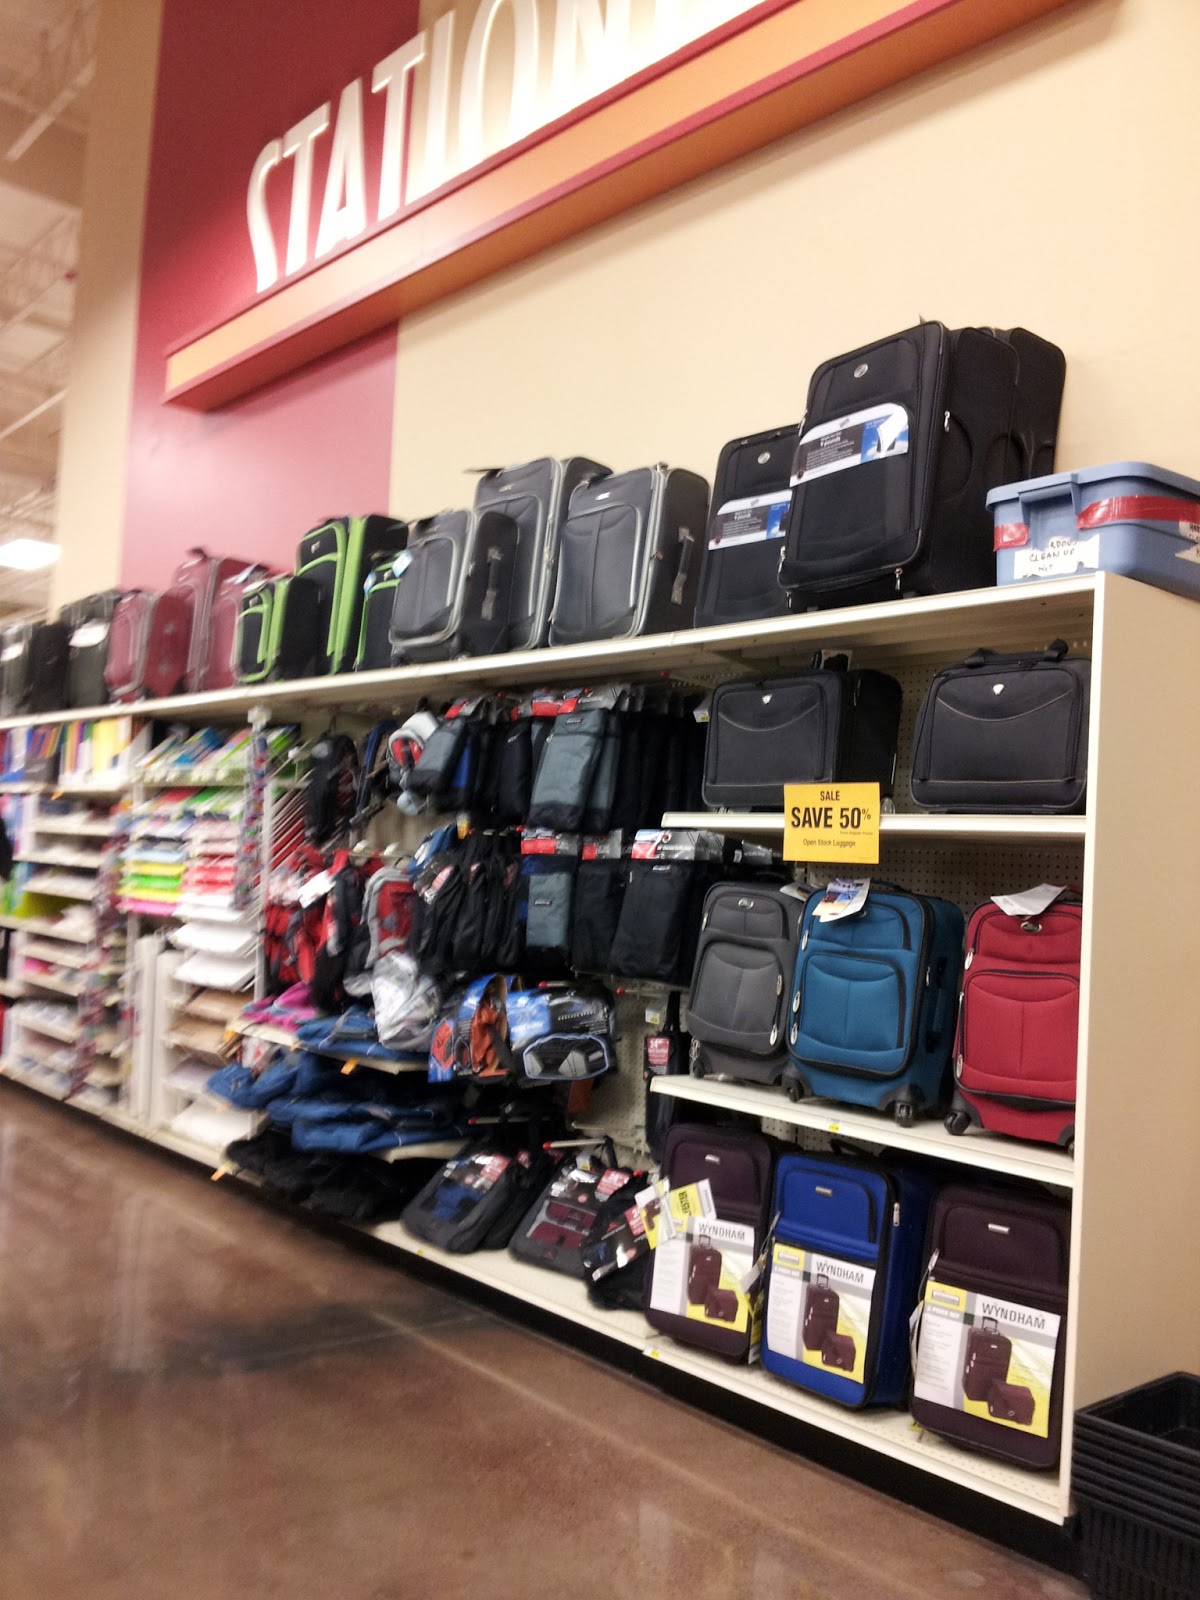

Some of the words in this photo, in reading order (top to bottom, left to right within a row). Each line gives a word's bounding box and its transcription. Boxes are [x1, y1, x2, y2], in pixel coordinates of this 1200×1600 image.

[247, 0, 690, 293] STATION
[820, 790, 840, 801] SALE
[791, 806, 833, 829] SAVE
[840, 807, 871, 829] 50%
[803, 838, 816, 847] Open
[817, 838, 832, 846] Stock
[833, 840, 856, 848] Luggage
[699, 1223, 745, 1241] WYNDHAM
[816, 1260, 865, 1284] WYNDHAM
[981, 1302, 1046, 1330] WYNDHAM
